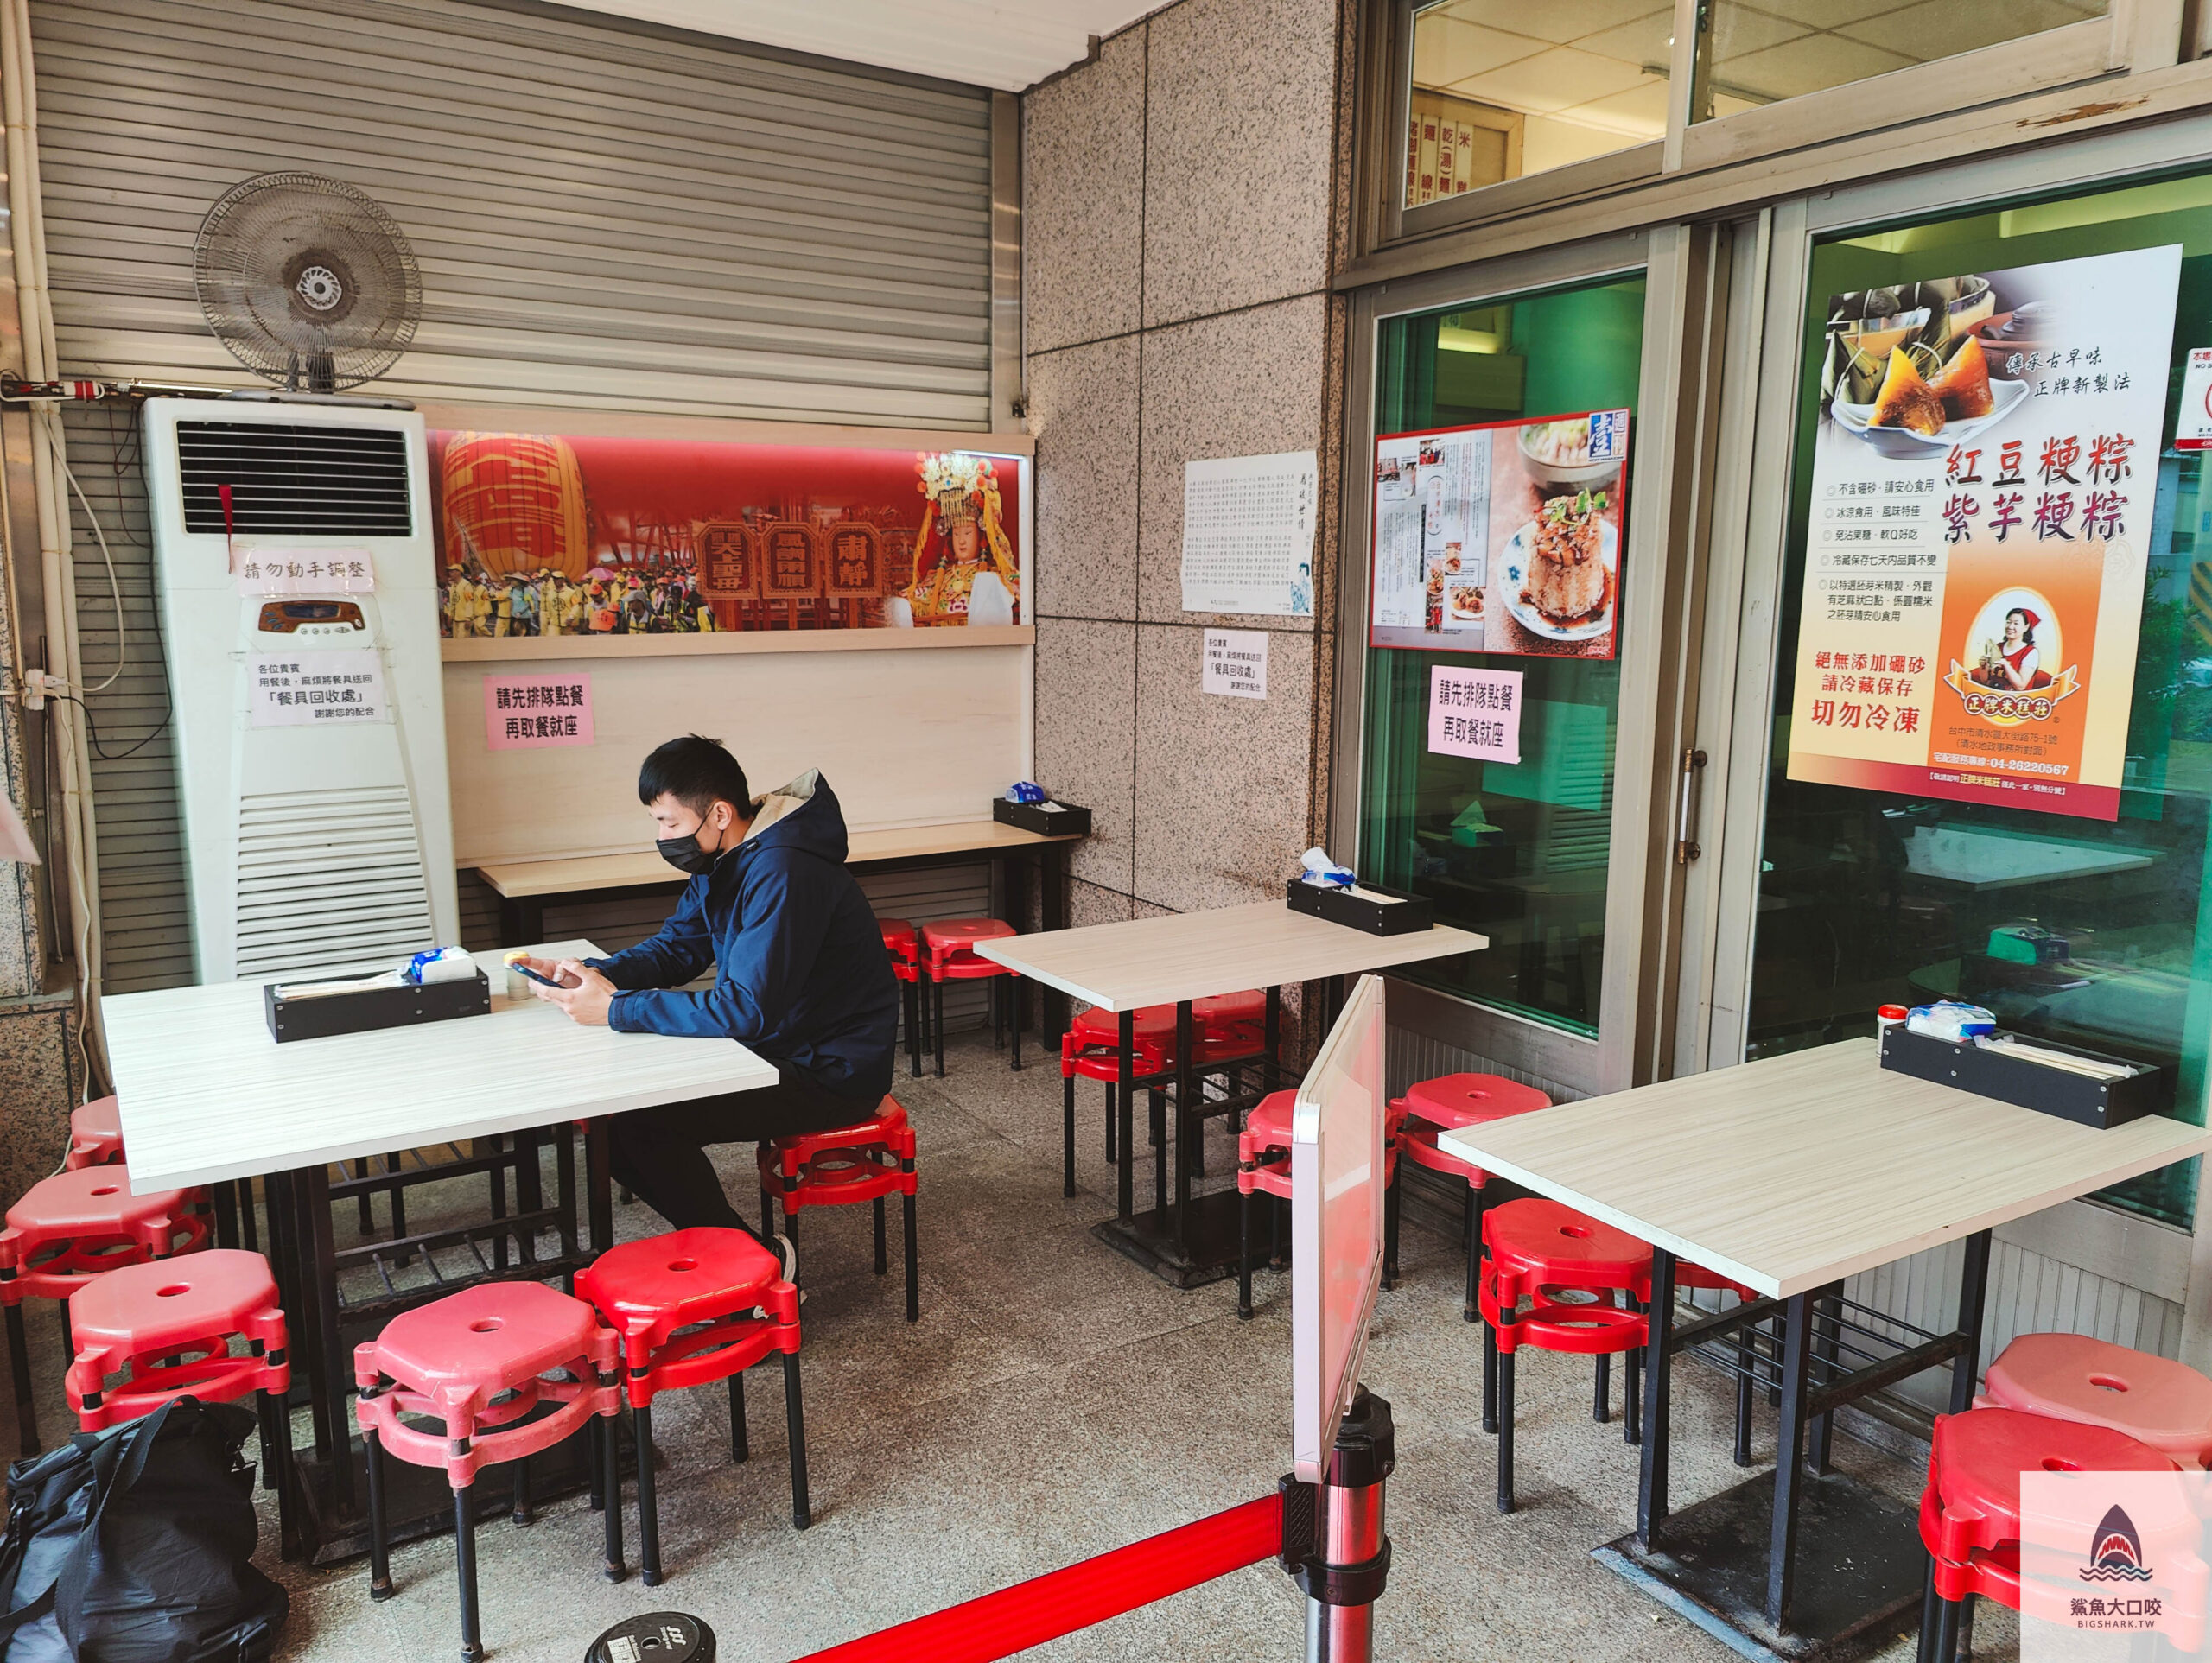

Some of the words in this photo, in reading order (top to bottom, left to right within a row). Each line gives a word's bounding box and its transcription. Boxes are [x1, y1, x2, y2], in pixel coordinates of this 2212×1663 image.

[2006, 346, 2102, 374] 傳承古早味
[2034, 372, 2131, 397] 正牌新製法
[1945, 433, 2135, 487] 紅豆粳粽
[1942, 490, 2129, 543] 紫芋粳粽
[244, 561, 365, 579] 請勿動手調整
[258, 663, 300, 674] 各位貴賓
[1815, 651, 1926, 674] 絕無添加硼砂
[496, 685, 583, 709] 請先排隊點餐
[1439, 679, 1513, 711] 請先排隊點餐
[1822, 674, 1914, 697] 請冷藏保存
[315, 707, 375, 718] 謝謝您的配合
[1811, 699, 1920, 733] 切勿冷凍
[1967, 697, 2049, 716] 正牌米糕莊
[505, 714, 578, 739] 再取餐就座
[1444, 716, 1504, 747] 再取餐就座
